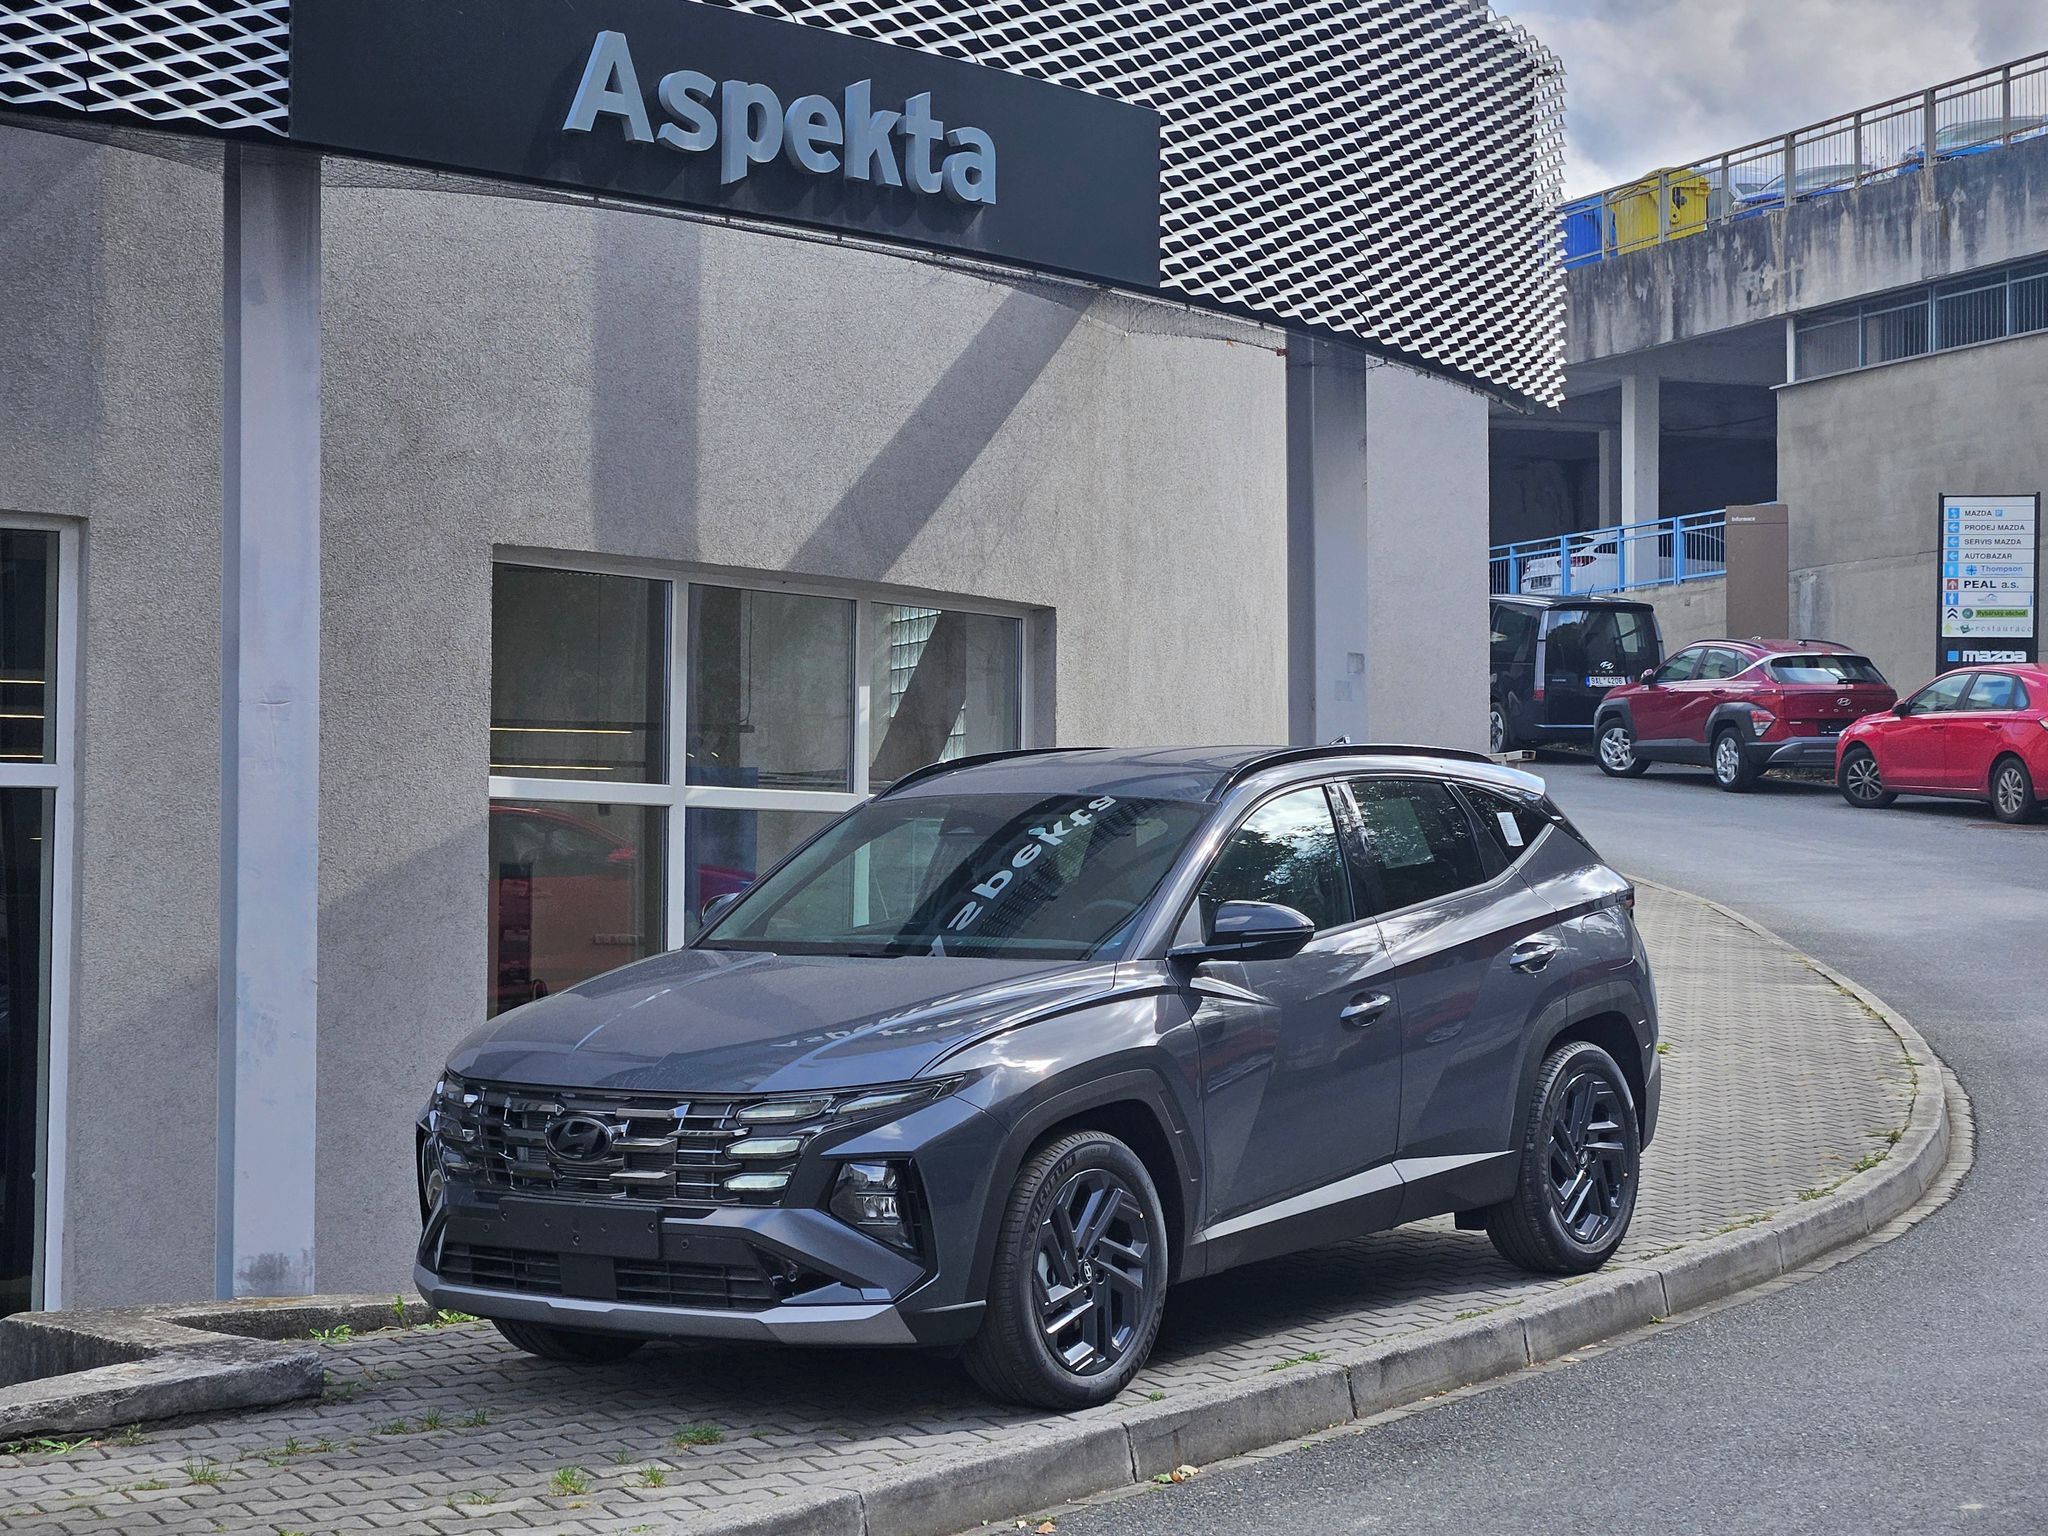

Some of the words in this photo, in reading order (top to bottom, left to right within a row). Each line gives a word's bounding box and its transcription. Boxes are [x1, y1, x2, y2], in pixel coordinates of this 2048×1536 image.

[562, 30, 997, 205] Aspekta
[1980, 565, 2023, 573] Thompson
[1963, 580, 1997, 588] PEAL
[1962, 650, 2027, 662] mazda
